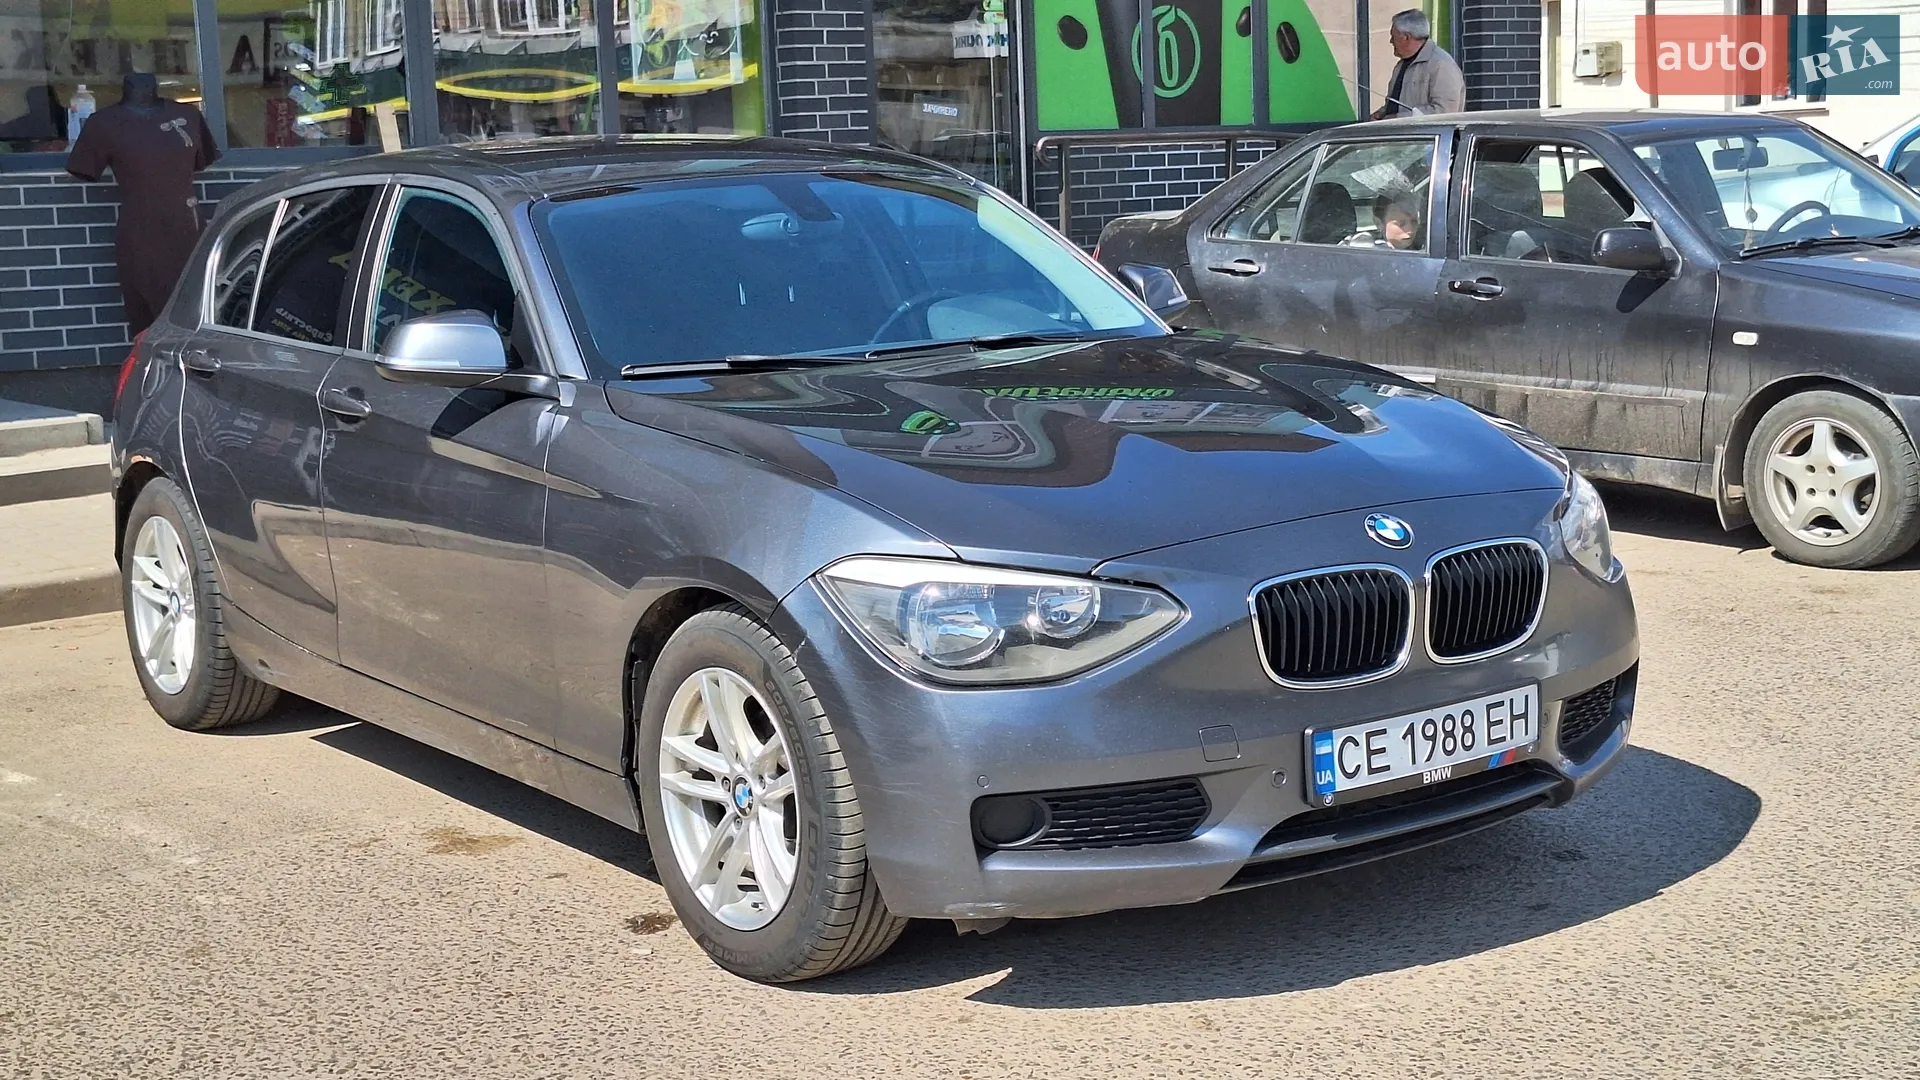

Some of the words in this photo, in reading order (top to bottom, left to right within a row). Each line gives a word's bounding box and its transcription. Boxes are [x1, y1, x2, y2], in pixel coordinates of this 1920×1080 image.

[1337, 728, 1391, 780] CE
[1401, 709, 1476, 766] 1988
[1485, 694, 1529, 747] EH
[1316, 771, 1334, 786] UA
[1422, 766, 1452, 784] BMW
